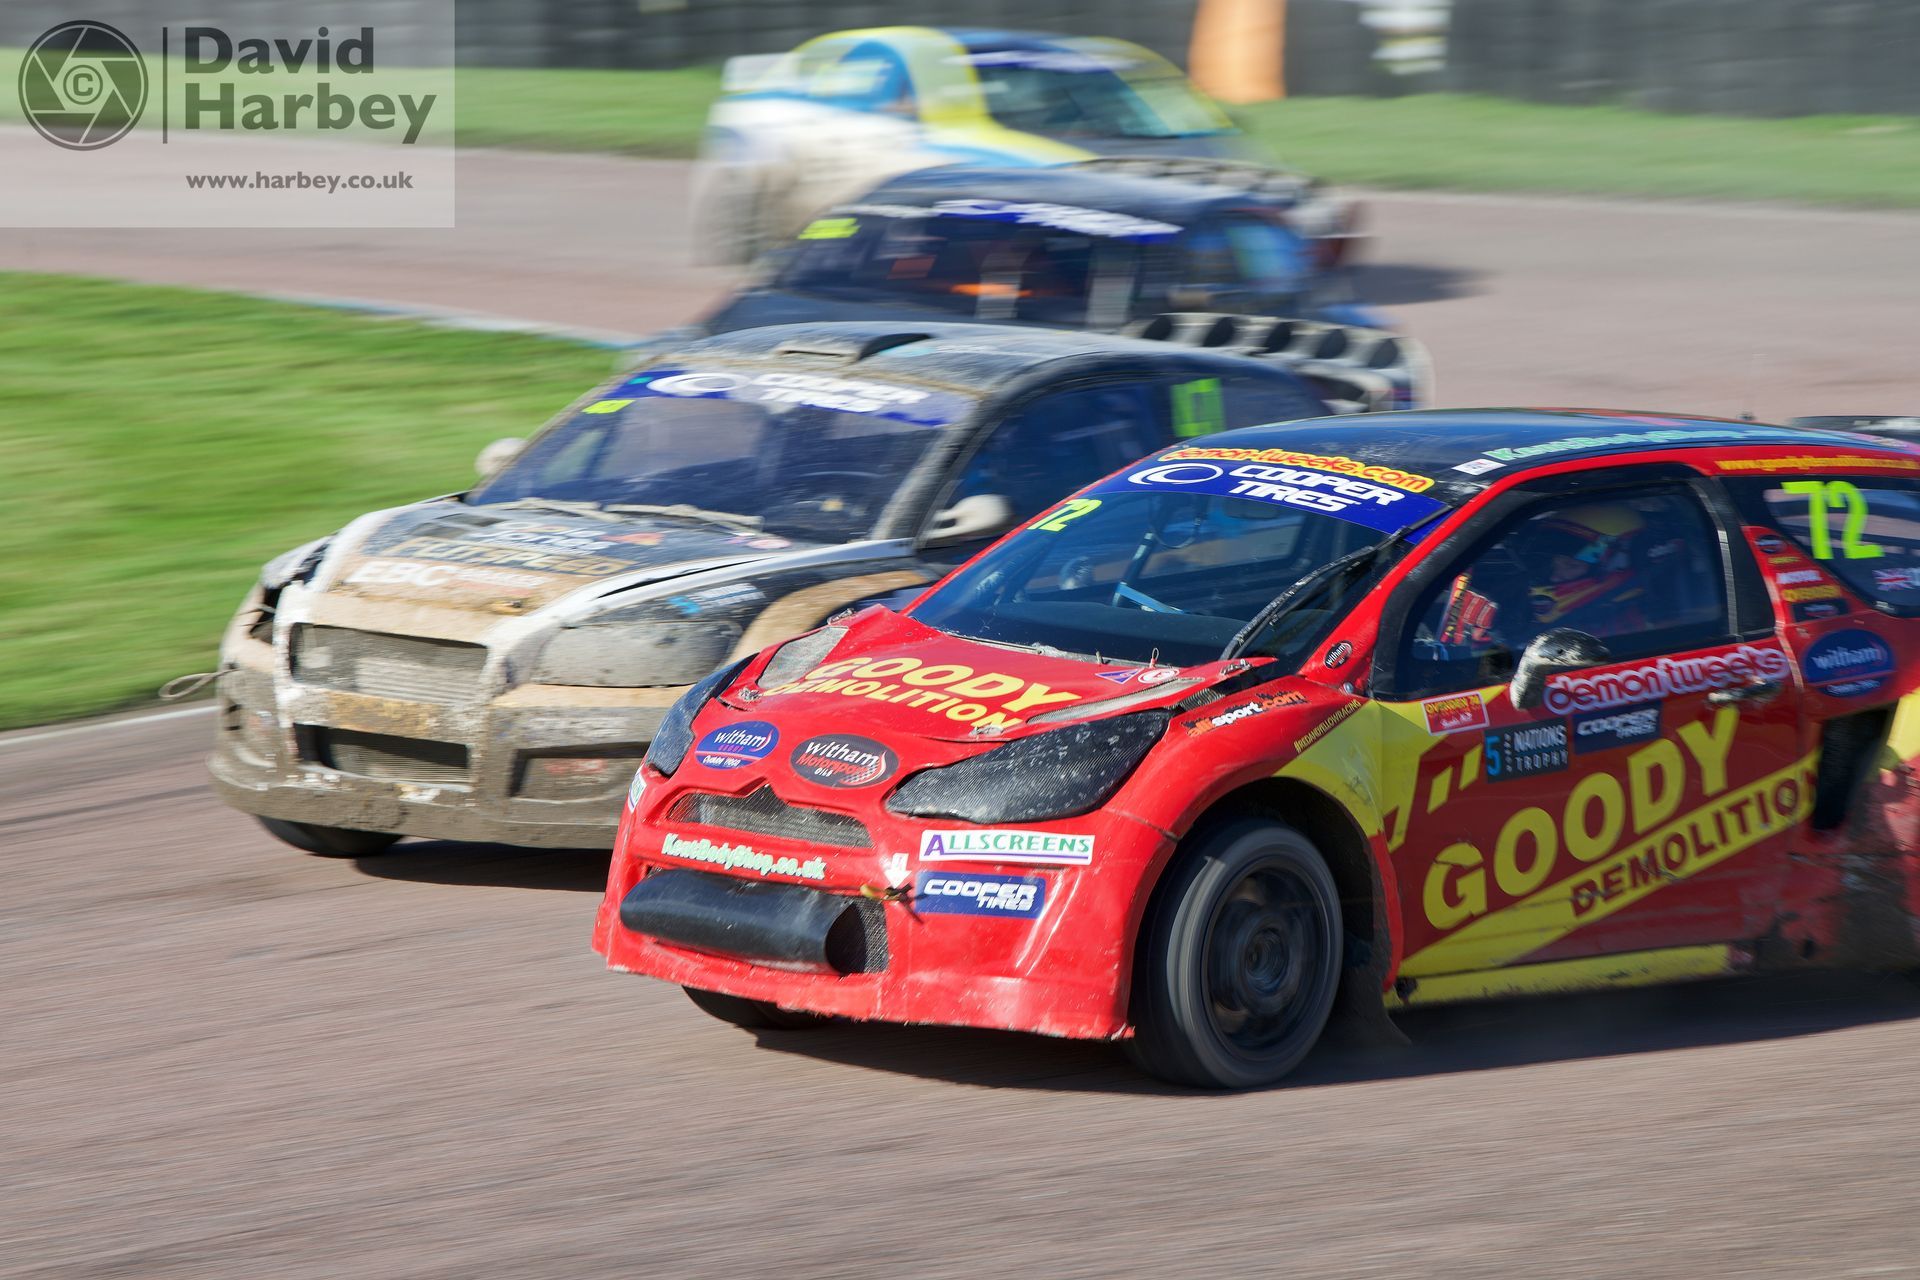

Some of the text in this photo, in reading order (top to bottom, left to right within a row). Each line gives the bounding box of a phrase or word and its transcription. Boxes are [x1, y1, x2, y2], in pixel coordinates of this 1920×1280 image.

[1158, 447, 1435, 493] demon-tweeks.com
[1229, 465, 1405, 506] COOPER
[1229, 481, 1361, 512] TIRES
[1027, 499, 1102, 532] 72
[1780, 480, 1885, 560] 72
[804, 656, 1083, 712] GOODY
[760, 678, 1023, 730] DEMOLITION
[714, 727, 766, 750] witham
[804, 741, 881, 767] witham
[1513, 725, 1567, 752] NATIONS
[1485, 735, 1502, 777] 5
[1514, 749, 1569, 773] TROPHY
[1421, 704, 1740, 931] GOODY
[923, 833, 1091, 857] ALLSCREENS
[923, 878, 1038, 901] COOPER
